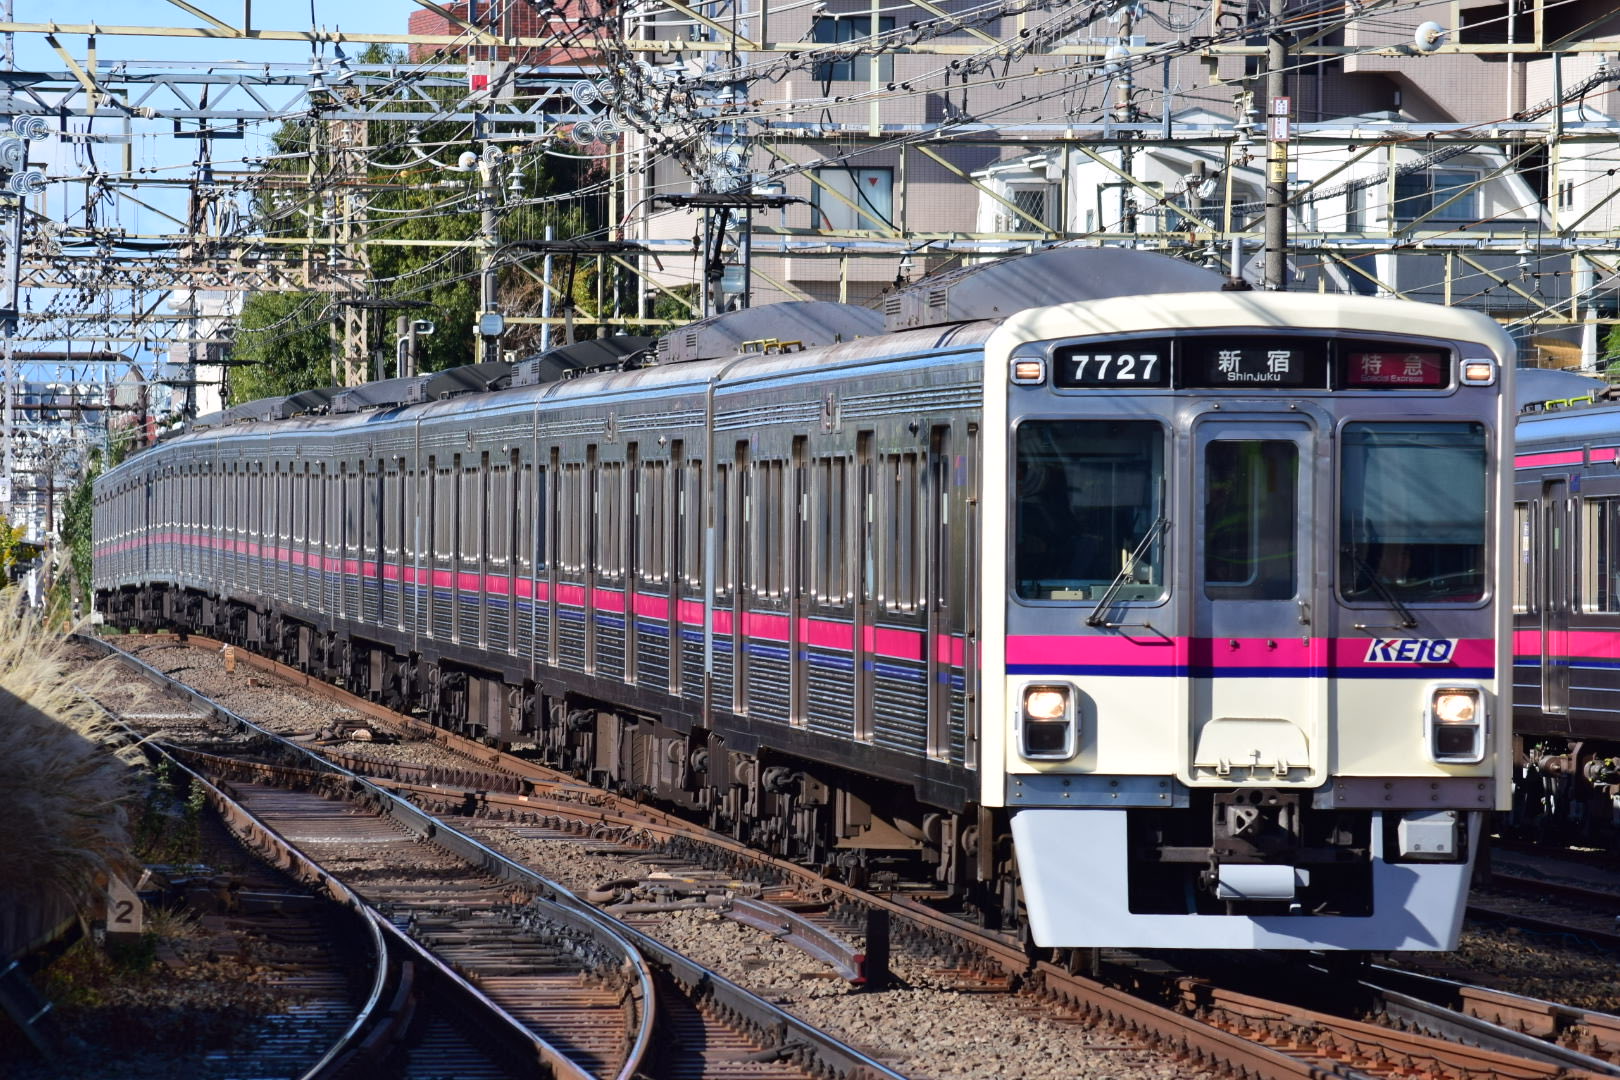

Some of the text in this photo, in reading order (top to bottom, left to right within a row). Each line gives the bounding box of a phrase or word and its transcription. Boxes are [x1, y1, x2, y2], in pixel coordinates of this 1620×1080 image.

[1072, 355, 1157, 380] 7727
[1218, 350, 1291, 373] 新宿
[1361, 353, 1423, 376] 特急
[1, 486, 7, 495] 2
[1368, 639, 1452, 662] KEIO
[115, 900, 133, 923] 2
